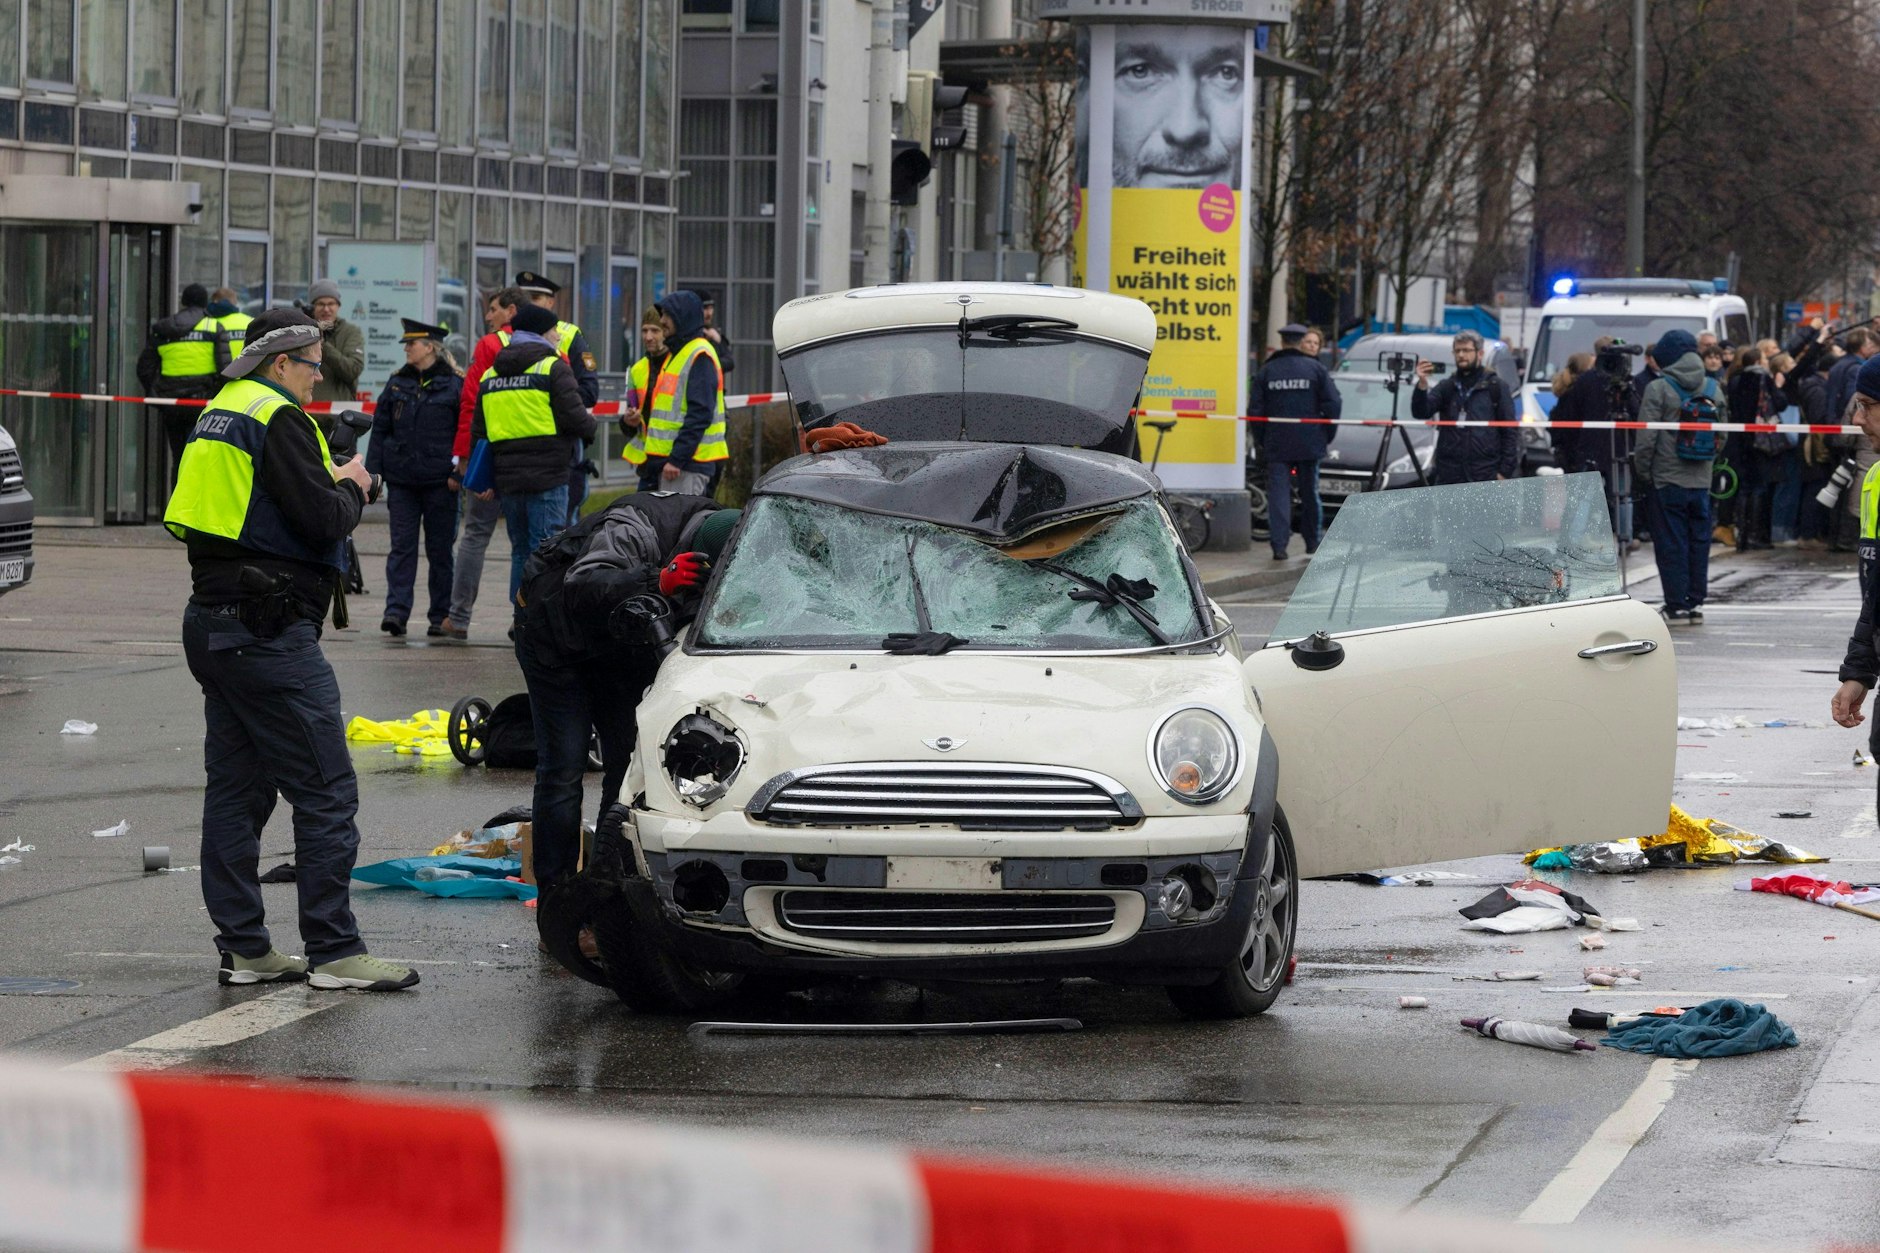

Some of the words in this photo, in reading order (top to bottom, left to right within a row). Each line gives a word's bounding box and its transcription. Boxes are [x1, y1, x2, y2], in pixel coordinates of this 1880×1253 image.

[1133, 247, 1226, 266] Freiheit
[1116, 271, 1190, 290] wählt
[1195, 273, 1236, 292] sich
[1195, 301, 1231, 316] von
[1155, 322, 1221, 341] elbst.
[488, 376, 530, 390] POLIZEI
[1268, 380, 1310, 391] POLIZEI
[1141, 387, 1217, 397] Demokraten
[6, 561, 23, 580] 8287
